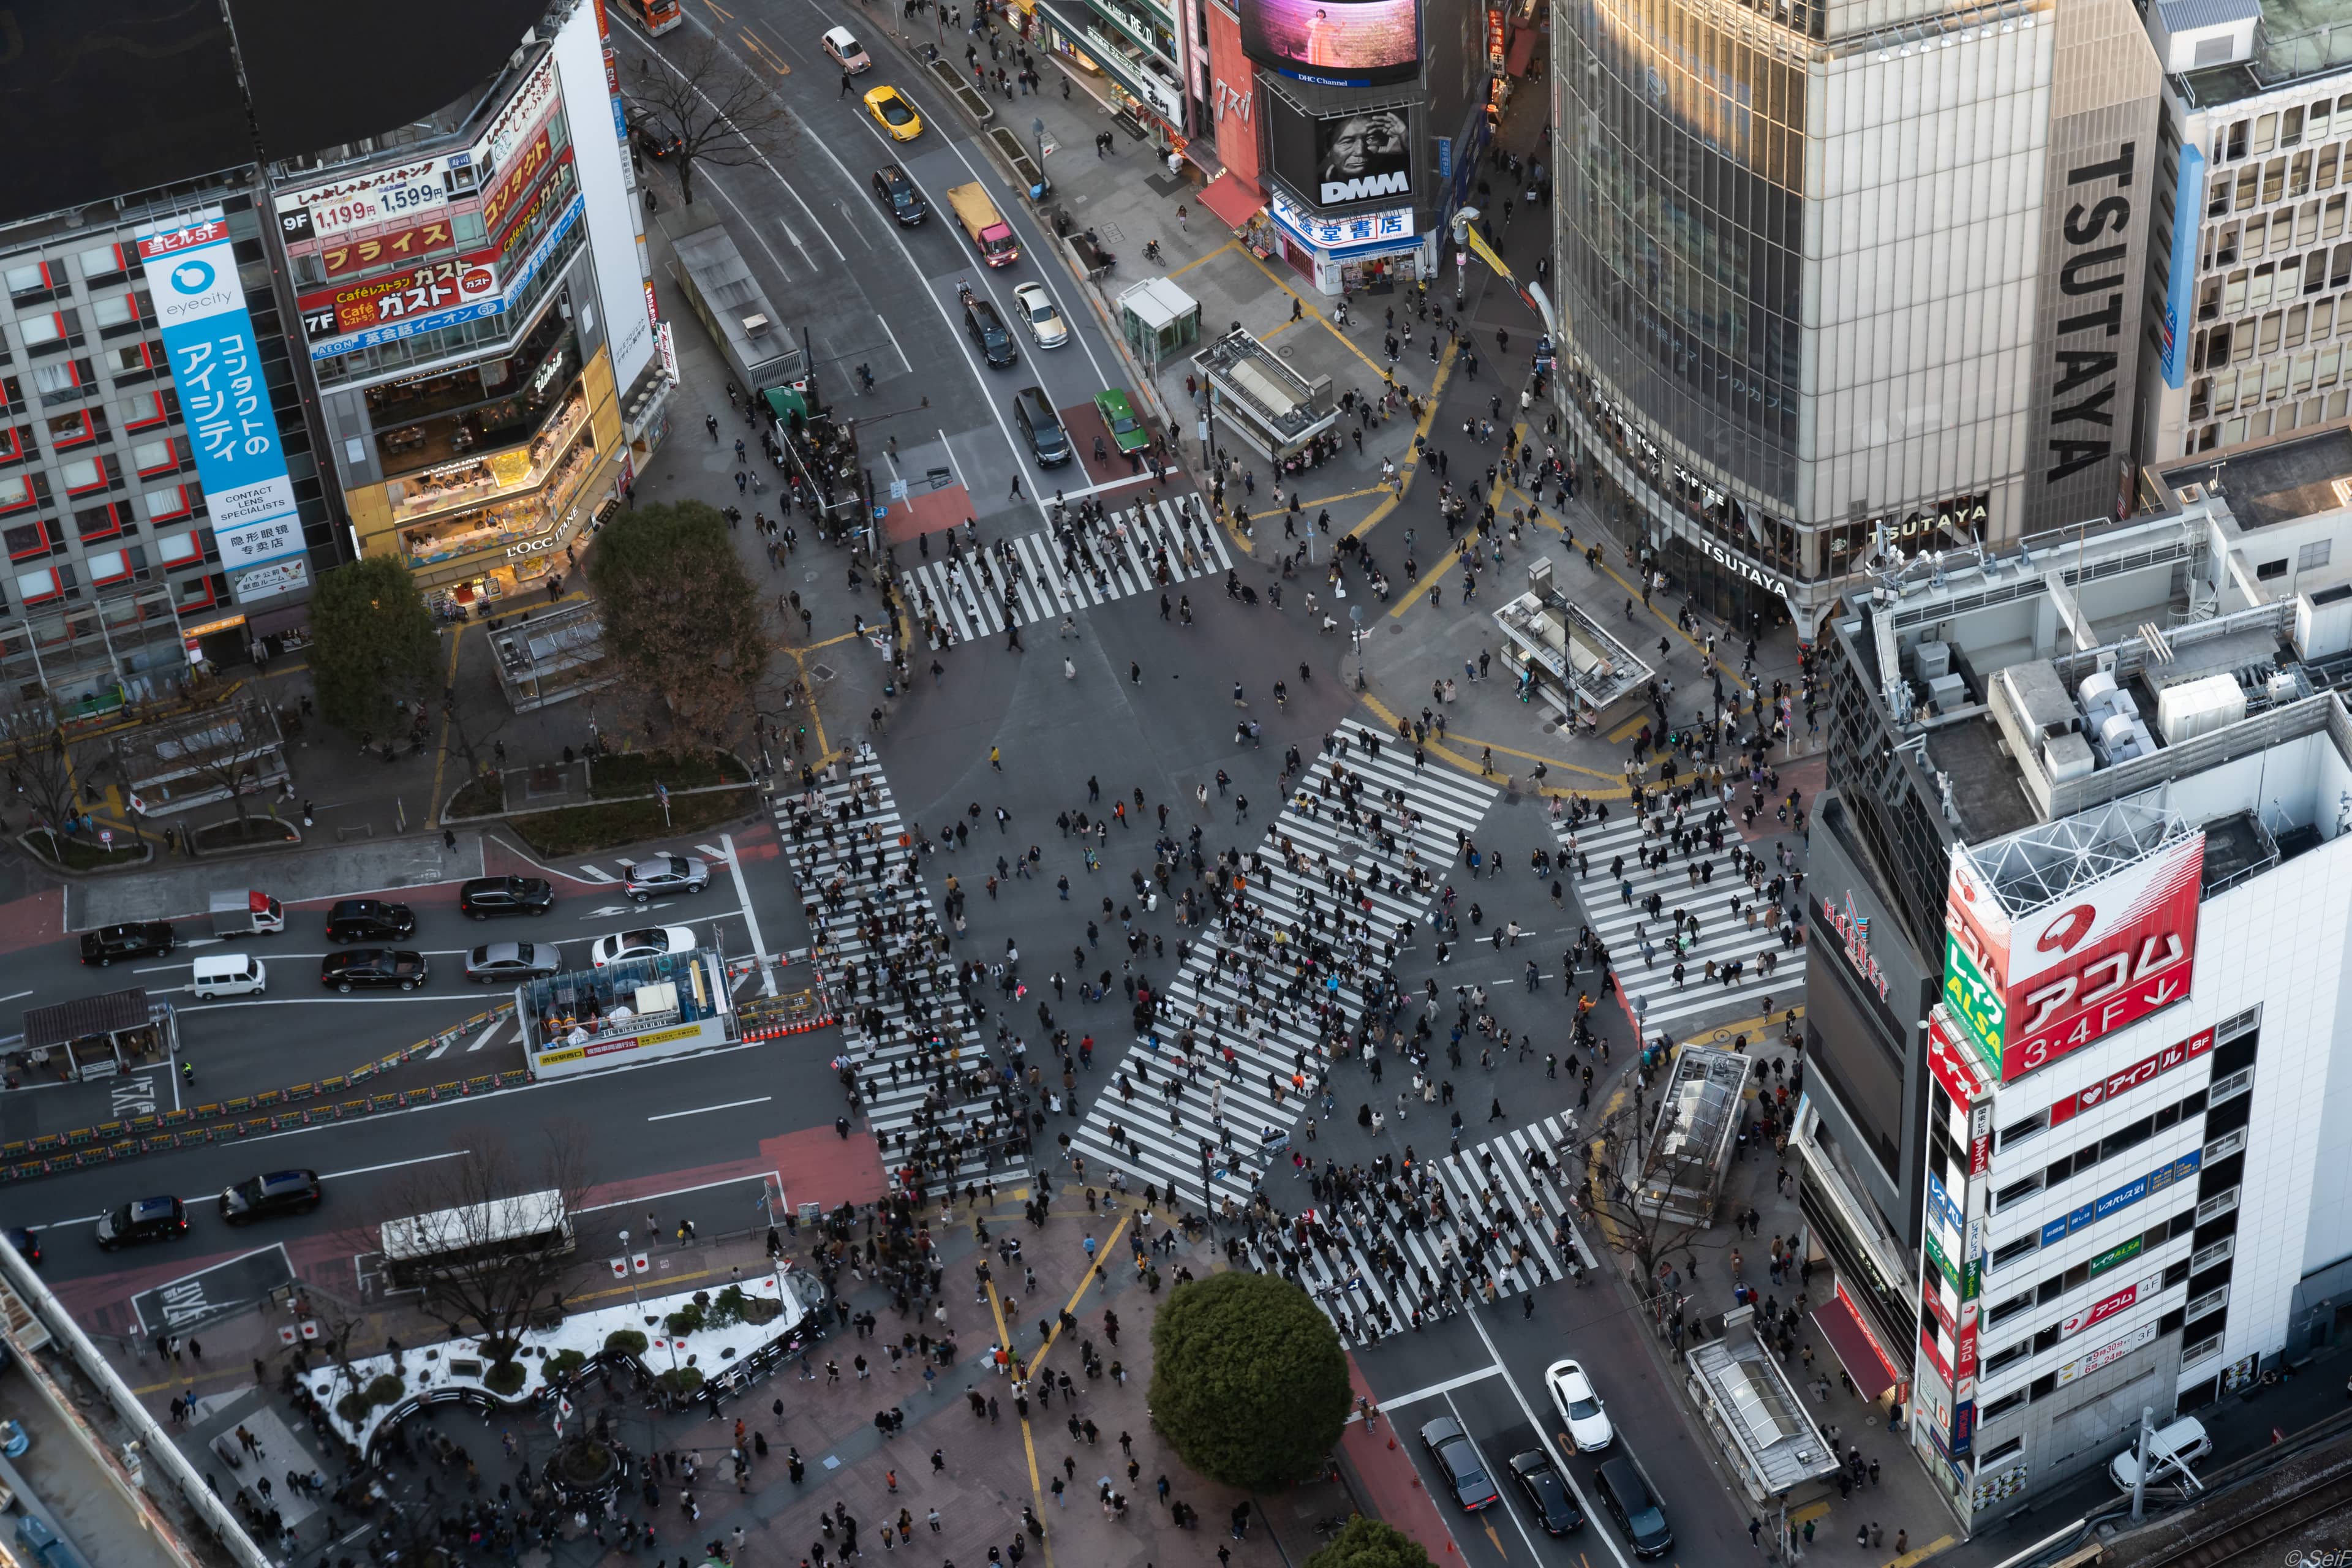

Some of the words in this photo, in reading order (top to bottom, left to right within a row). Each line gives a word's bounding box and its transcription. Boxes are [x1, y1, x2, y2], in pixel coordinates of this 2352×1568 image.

[1298, 74, 1316, 83] DHC
[381, 184, 442, 213] 1,599円
[484, 140, 547, 228] コンタクト
[540, 164, 569, 208] ガスト
[1321, 171, 1409, 204] DMM
[284, 213, 306, 231] 9F
[315, 202, 376, 230] 1,199円
[325, 224, 450, 271] プライス
[336, 277, 409, 304] Caféレストラン
[415, 260, 472, 287] ガスト
[466, 277, 490, 288] ガスト
[508, 274, 527, 303] AEON
[167, 292, 232, 315] eyecity
[341, 303, 373, 318] Café
[379, 284, 451, 320] ガスト
[2047, 141, 2136, 484] TSUTAYA
[305, 313, 334, 332] 7F
[317, 339, 353, 356] AEON
[365, 309, 471, 345] 英会話イーオン
[480, 304, 494, 314] 6F
[178, 342, 238, 461] アイシティ
[219, 334, 270, 455] コンタクトの
[1598, 393, 1665, 464] STRBCK
[446, 464, 480, 475] PROVENCE
[221, 499, 285, 521] SPECIALISTS
[225, 486, 272, 503] CONTACT
[238, 497, 263, 508] LENS
[231, 524, 289, 547] 隐形眼镜
[506, 505, 578, 557] L'OCCITANE
[1868, 505, 1986, 544] TSUTAYA
[241, 538, 284, 555] 专卖店
[245, 568, 280, 582] ハチ公前
[1702, 538, 1787, 598] TSUTAYA
[1950, 942, 2002, 1024] レイク
[2024, 933, 2184, 1035] アコム
[1947, 976, 2000, 1059] ALSA
[2109, 1048, 2182, 1094] アイフル
[2192, 1036, 2209, 1050] 8F
[1974, 1144, 1986, 1173] アイフル
[1944, 1261, 1959, 1284] ALS
[2096, 1292, 2133, 1317] アコム
[2142, 1278, 2159, 1292] 4F
[2138, 1327, 2154, 1341] 3F
